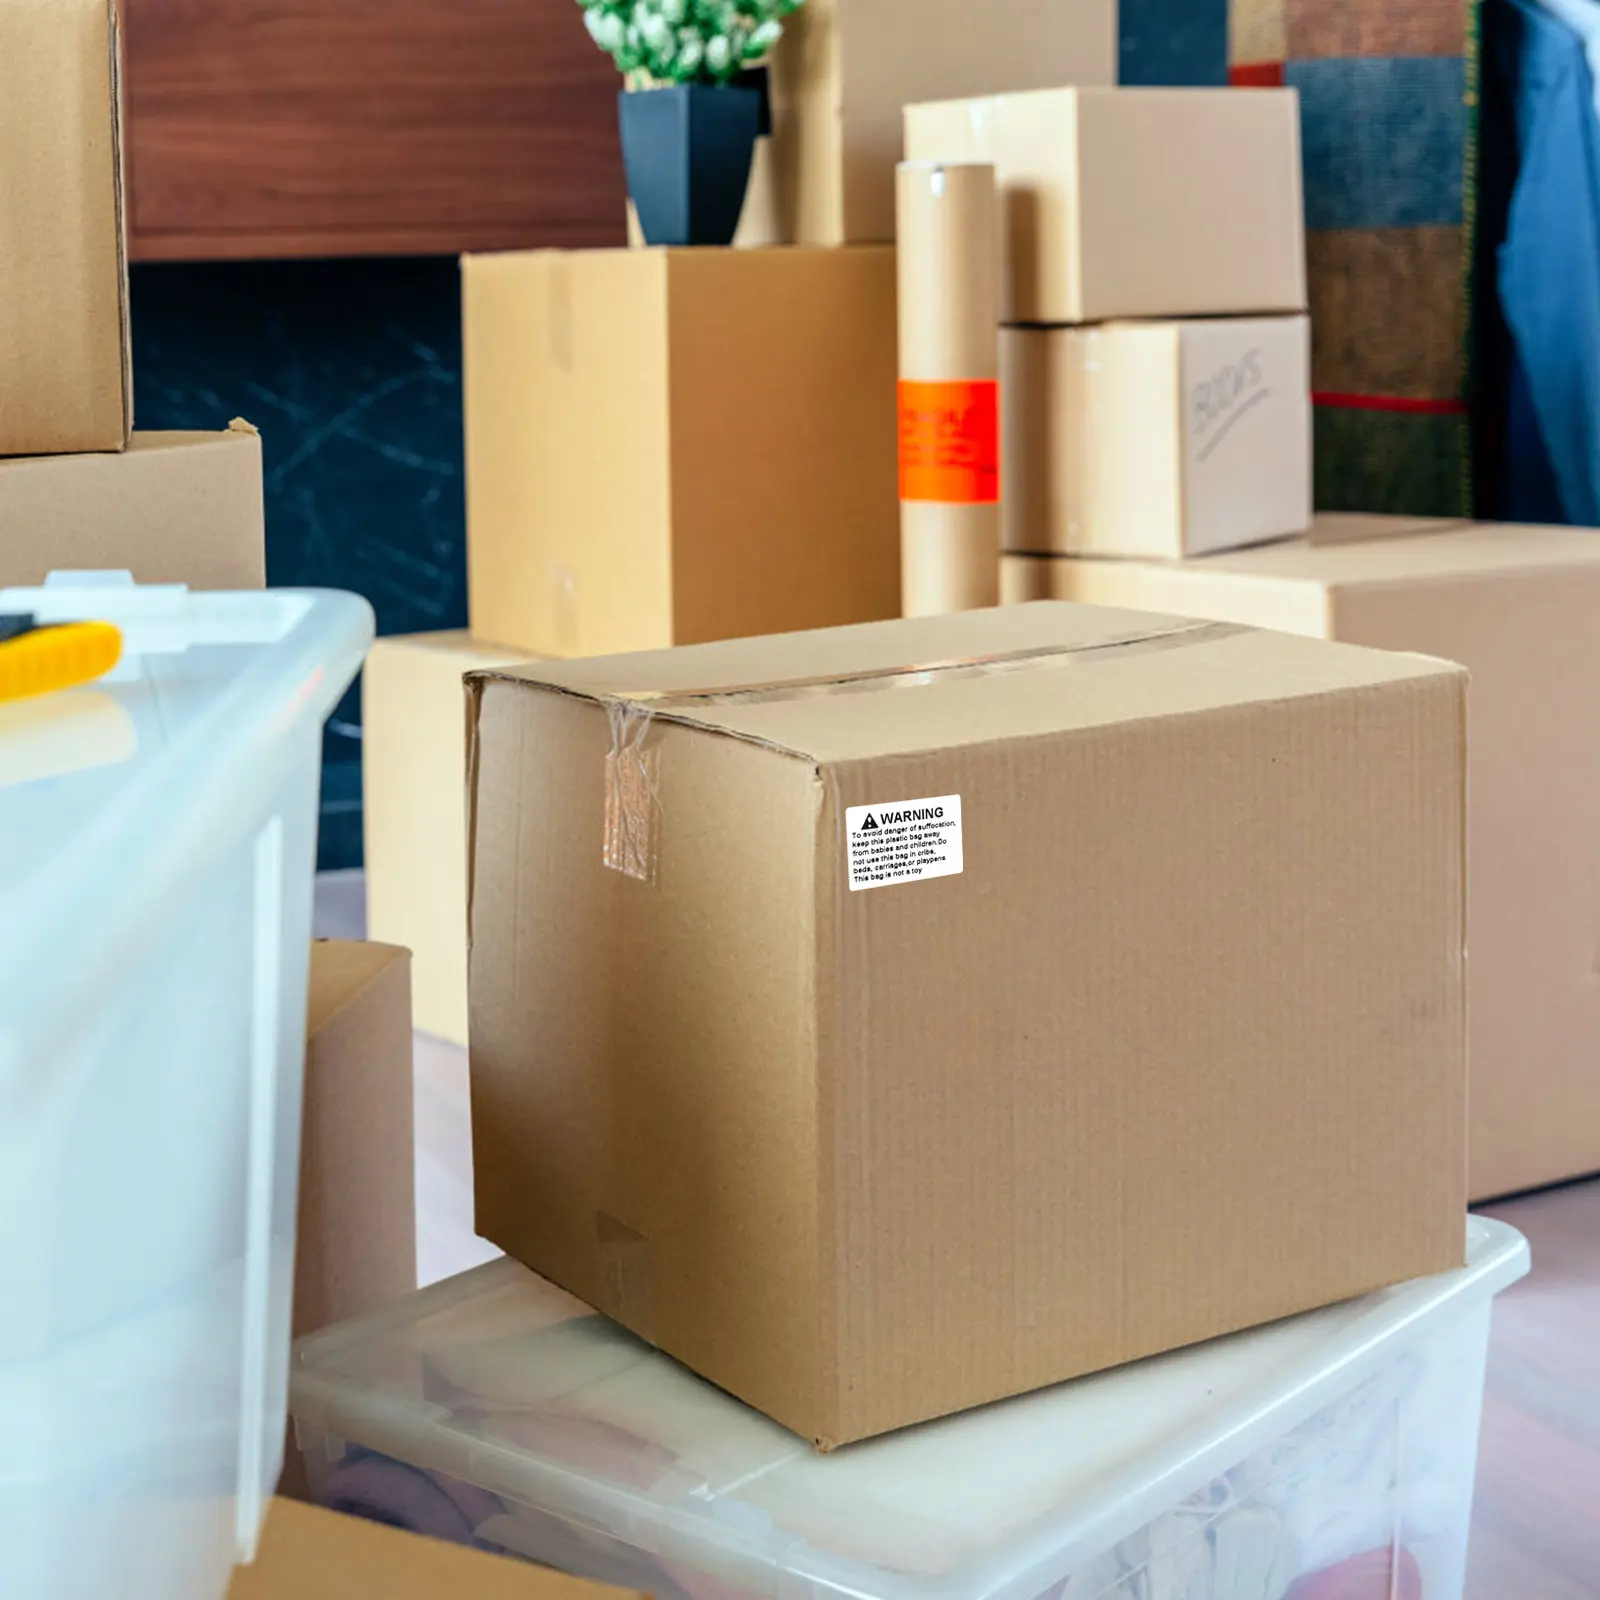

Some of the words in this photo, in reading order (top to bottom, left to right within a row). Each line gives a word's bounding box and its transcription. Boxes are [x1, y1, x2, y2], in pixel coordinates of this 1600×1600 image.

[880, 807, 943, 824] WARNING
[884, 827, 907, 835] danger
[886, 835, 907, 844] plastic
[871, 846, 893, 854] babies
[917, 855, 945, 865] playpens
